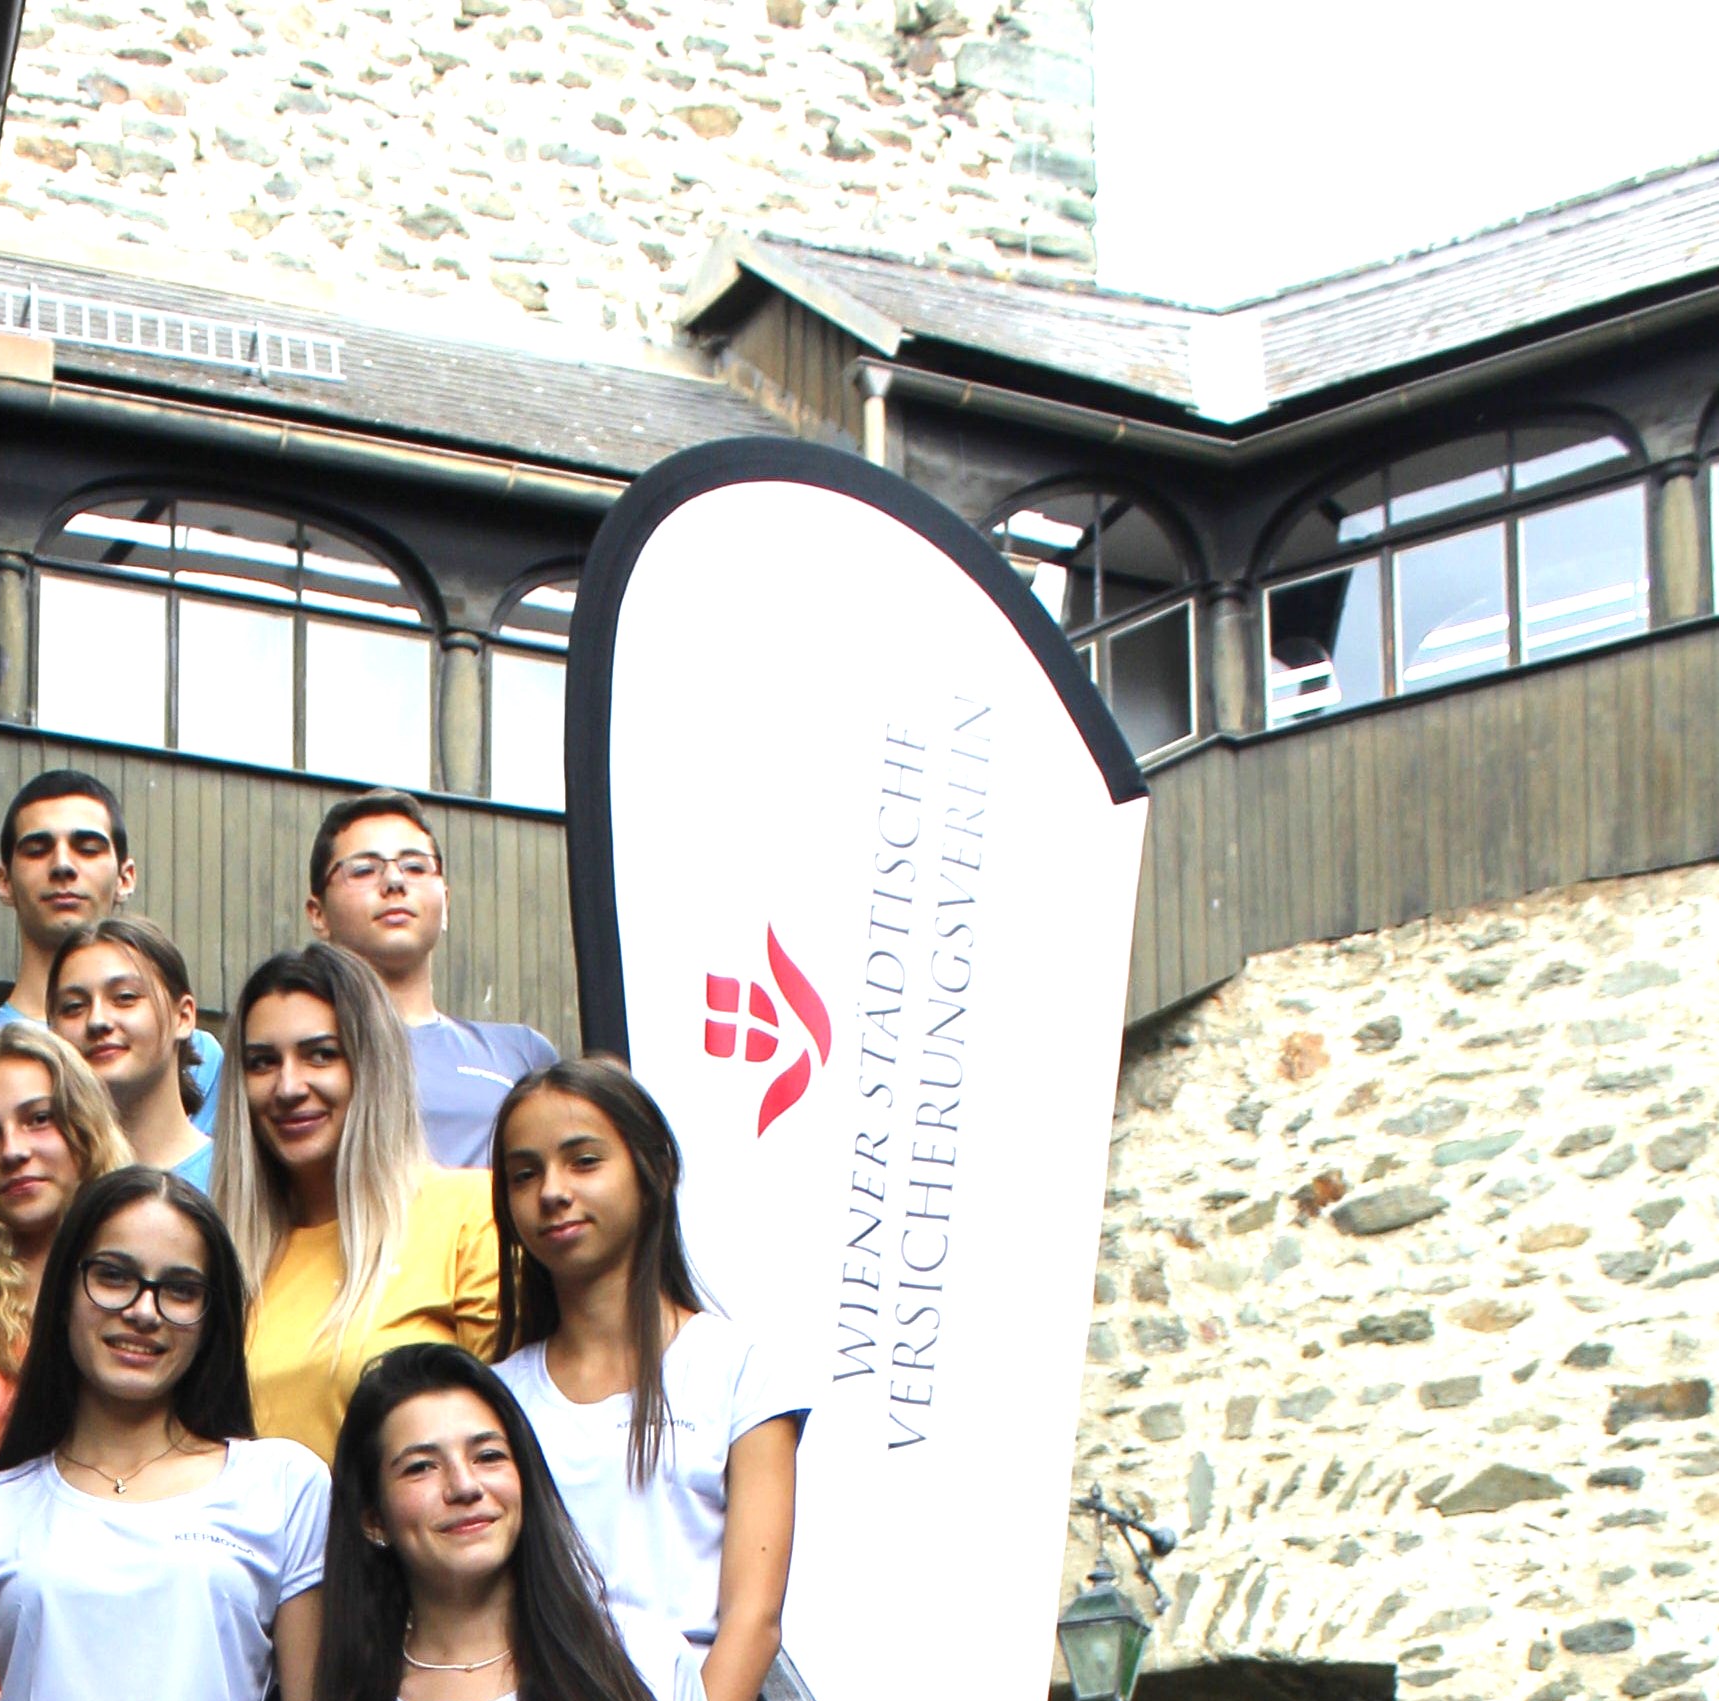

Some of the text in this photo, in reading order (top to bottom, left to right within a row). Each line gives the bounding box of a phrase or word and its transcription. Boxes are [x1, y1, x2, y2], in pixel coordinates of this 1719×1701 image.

[832, 723, 926, 1382] WIENER STÄDTISCHE
[888, 695, 991, 1450] VERSICHERUNGSVEREIN
